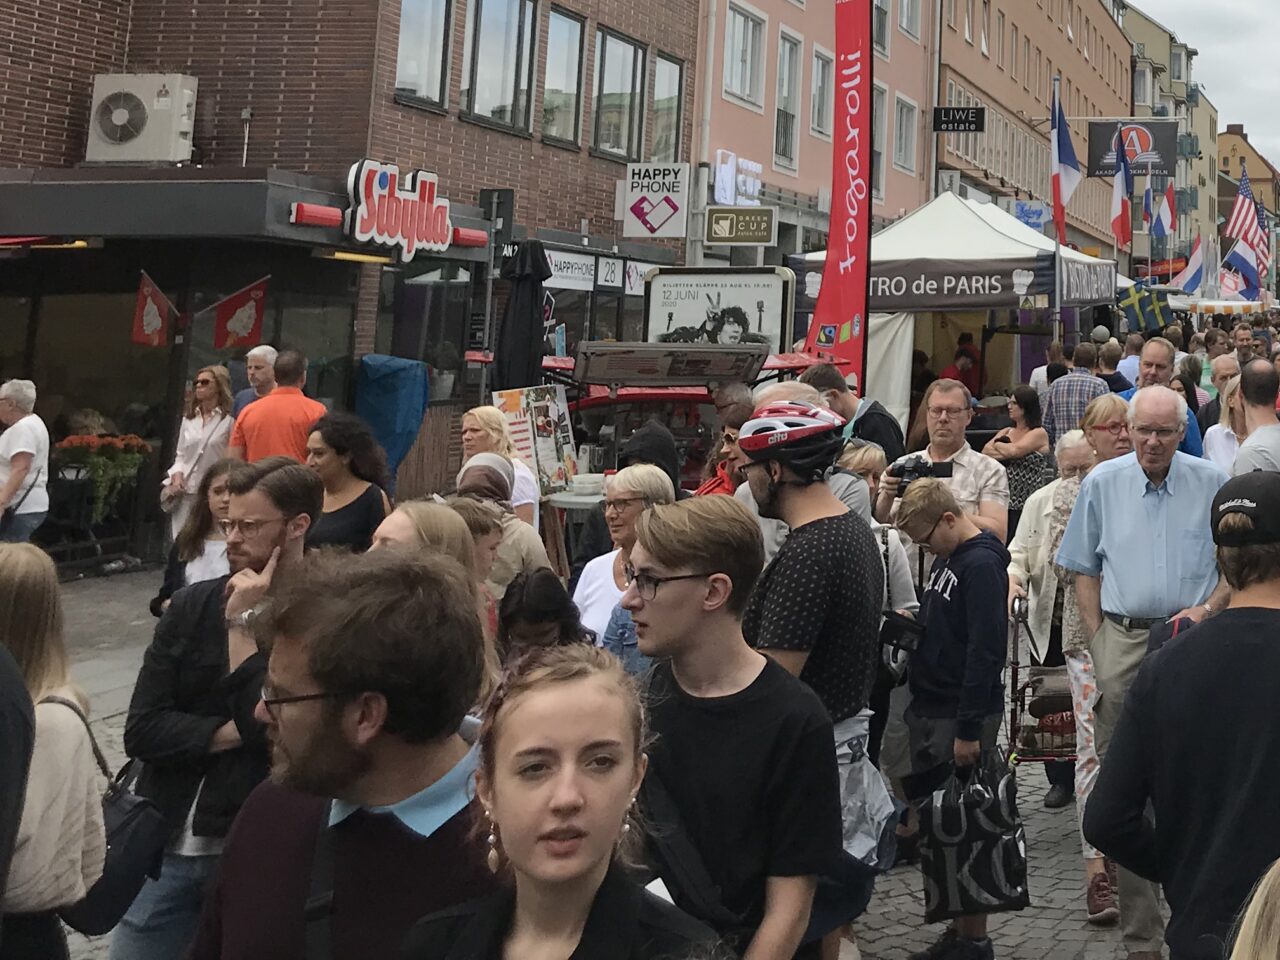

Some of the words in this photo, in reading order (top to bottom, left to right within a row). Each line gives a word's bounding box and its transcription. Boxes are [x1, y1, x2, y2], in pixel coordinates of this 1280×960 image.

[941, 109, 977, 121] LIWE
[941, 122, 976, 131] estate
[631, 168, 681, 180] HAPPY
[630, 181, 681, 193] PHONE
[360, 168, 450, 254] Sibylla
[738, 222, 767, 230] CUP
[553, 260, 595, 277] HAPPYPHONE
[604, 261, 617, 283] 28
[912, 274, 938, 295] de
[943, 275, 1002, 295] PARIS
[662, 290, 672, 300] 12
[674, 290, 699, 300] JUNI
